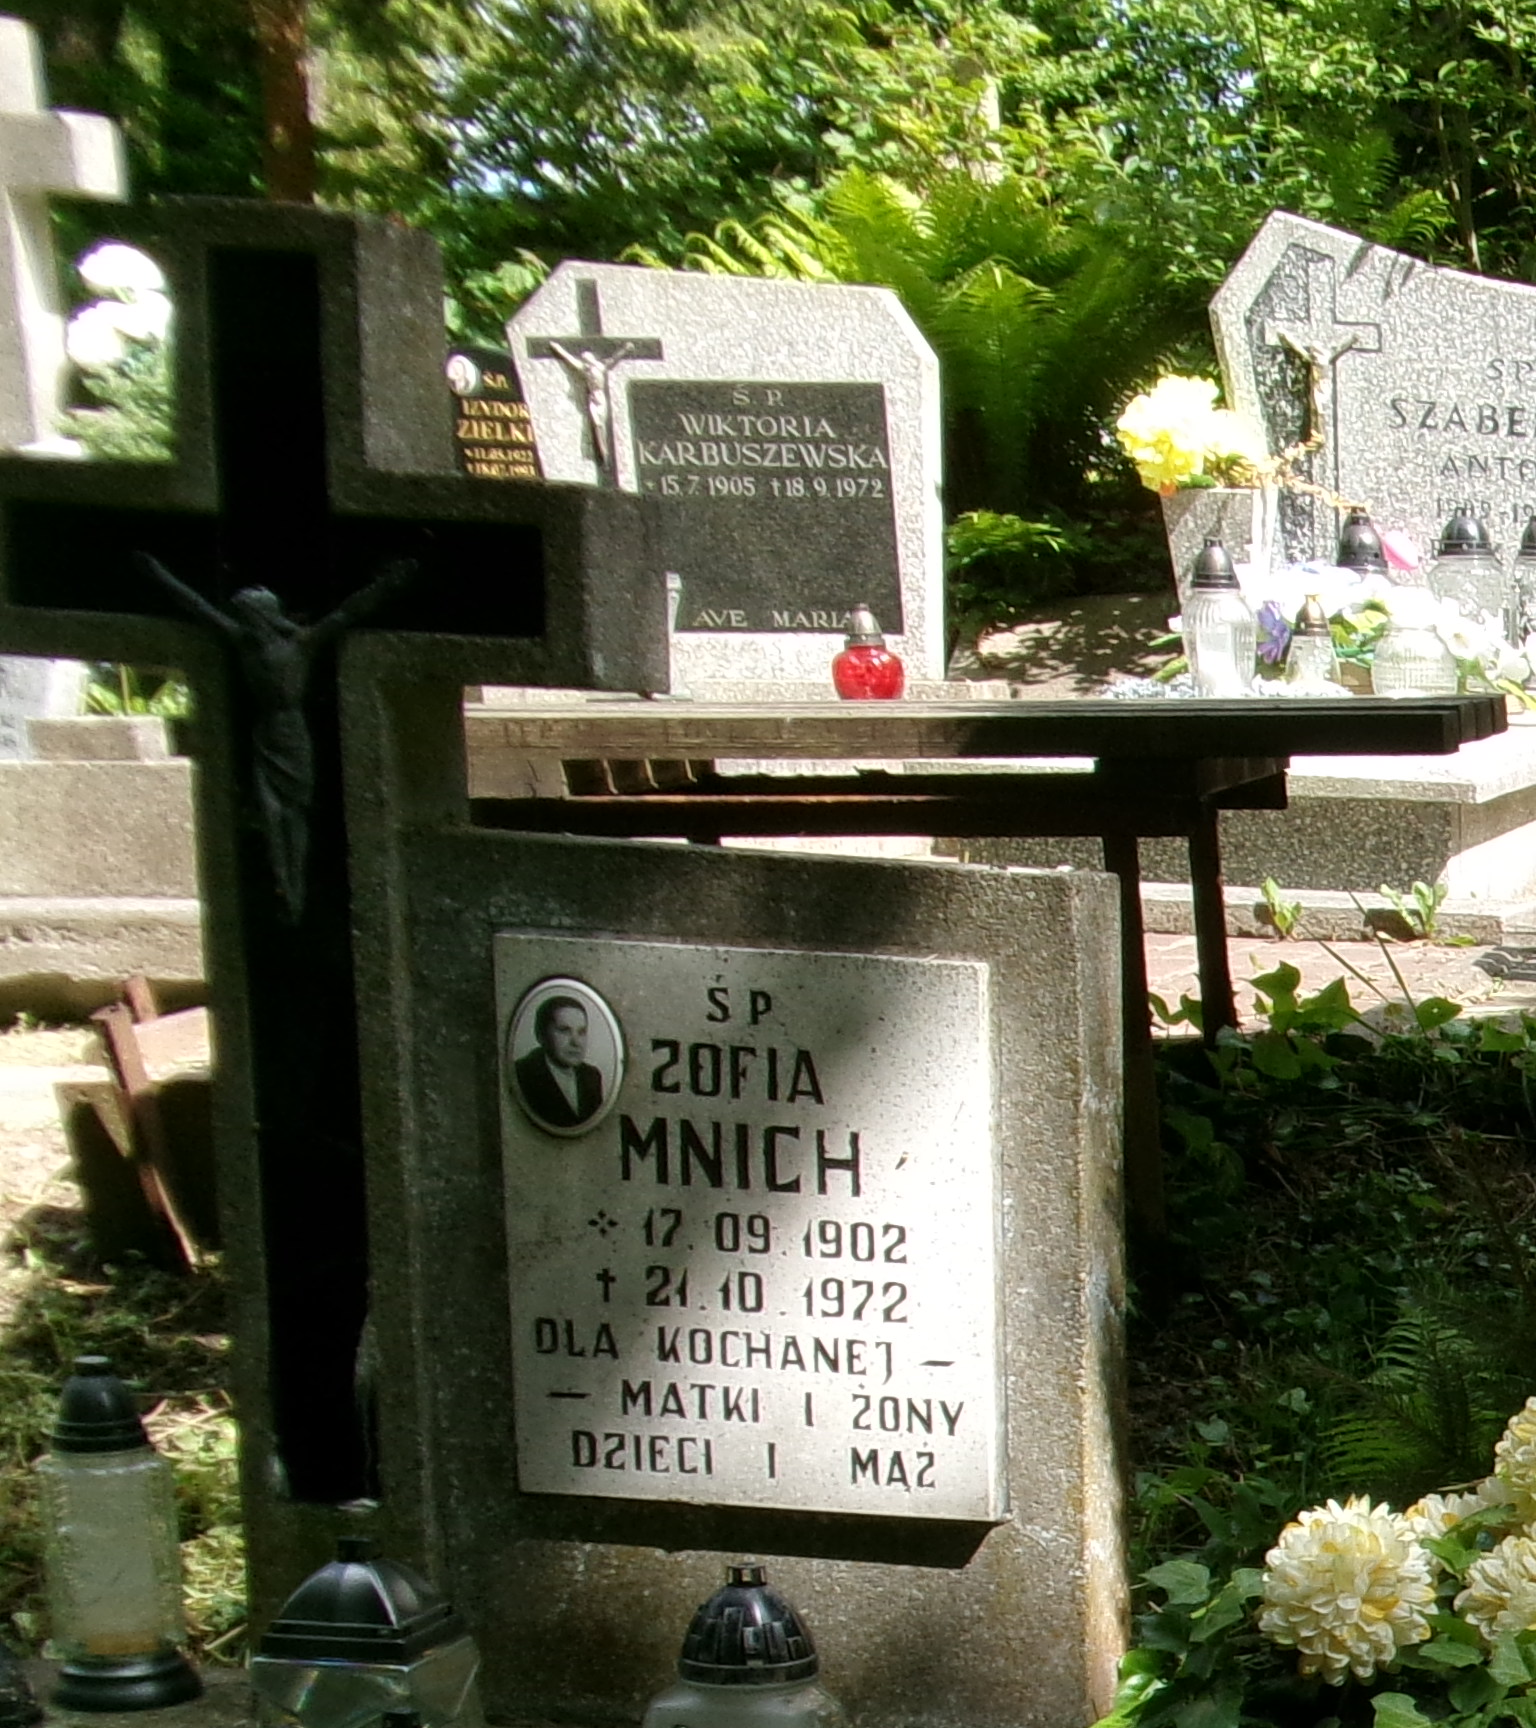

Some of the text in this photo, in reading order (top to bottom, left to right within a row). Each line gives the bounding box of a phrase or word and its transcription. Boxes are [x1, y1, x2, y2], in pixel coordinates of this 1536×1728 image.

[678, 412, 837, 438] WIKTORIA
[637, 439, 890, 469] KARBUSZEWSKA
[692, 608, 748, 628] AVE
[650, 1038, 825, 1105] ZOFIA
[619, 1114, 862, 1198] MNICH
[535, 1316, 620, 1360] DLA
[656, 1325, 894, 1386] KOCHANEJ
[621, 1378, 761, 1424] MATKI
[804, 1391, 815, 1427] I
[851, 1382, 965, 1437] ŻONY
[571, 1429, 713, 1475] DZIECI
[766, 1441, 776, 1479] I
